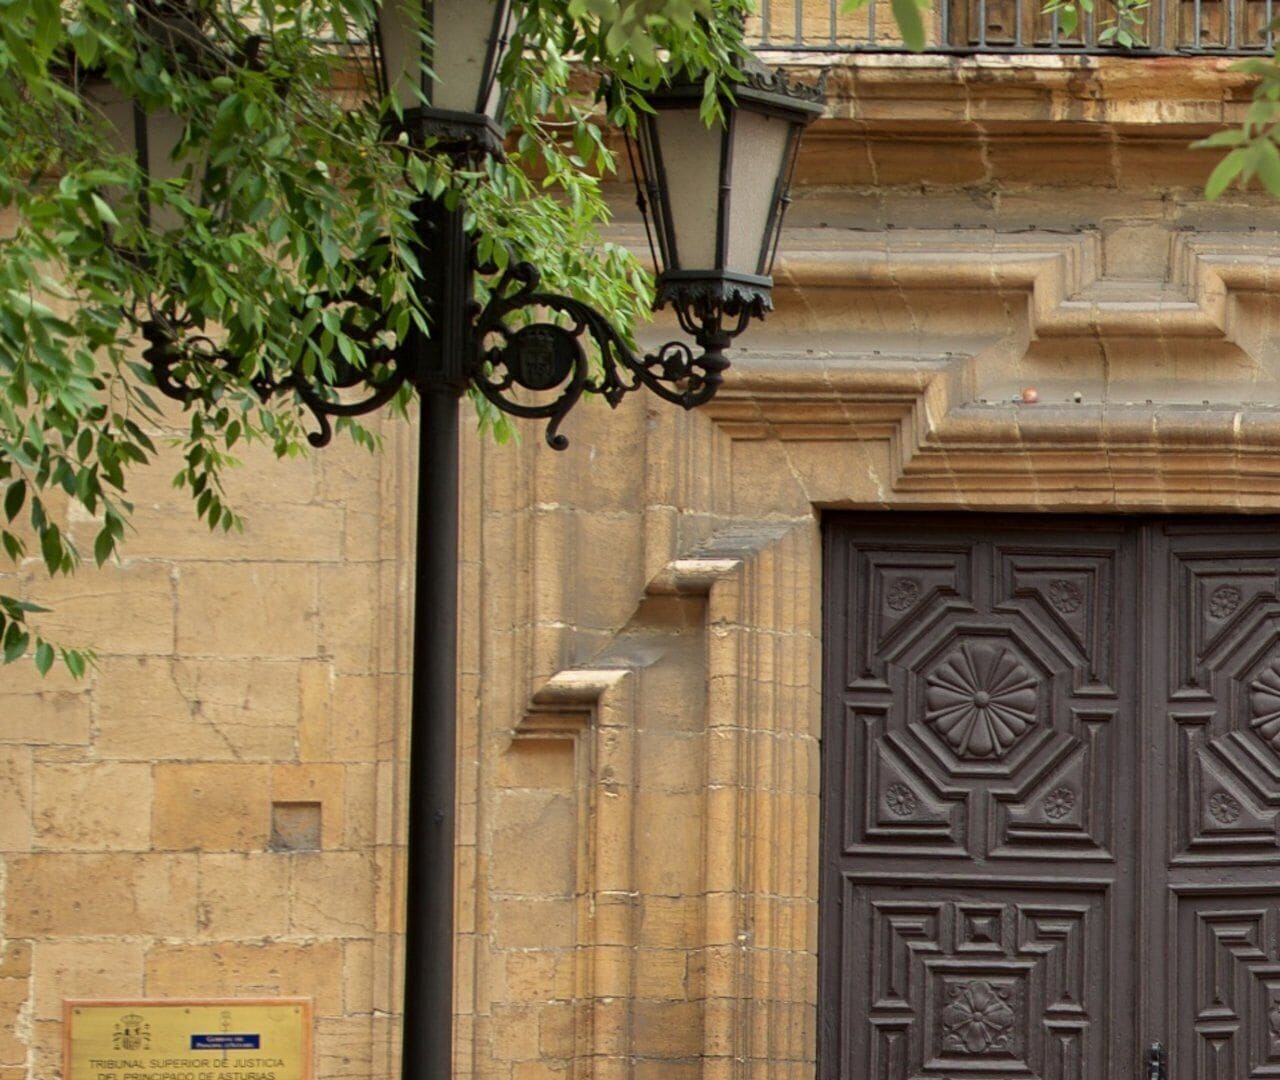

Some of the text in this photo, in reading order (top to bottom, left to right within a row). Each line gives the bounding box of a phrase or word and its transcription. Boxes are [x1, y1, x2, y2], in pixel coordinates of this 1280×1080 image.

[88, 1058, 285, 1069] TRIBUNAL SUPERIOR DE JUSTICIA
[198, 1072, 215, 1080] DE
[217, 1072, 276, 1080] ASTURIAS
